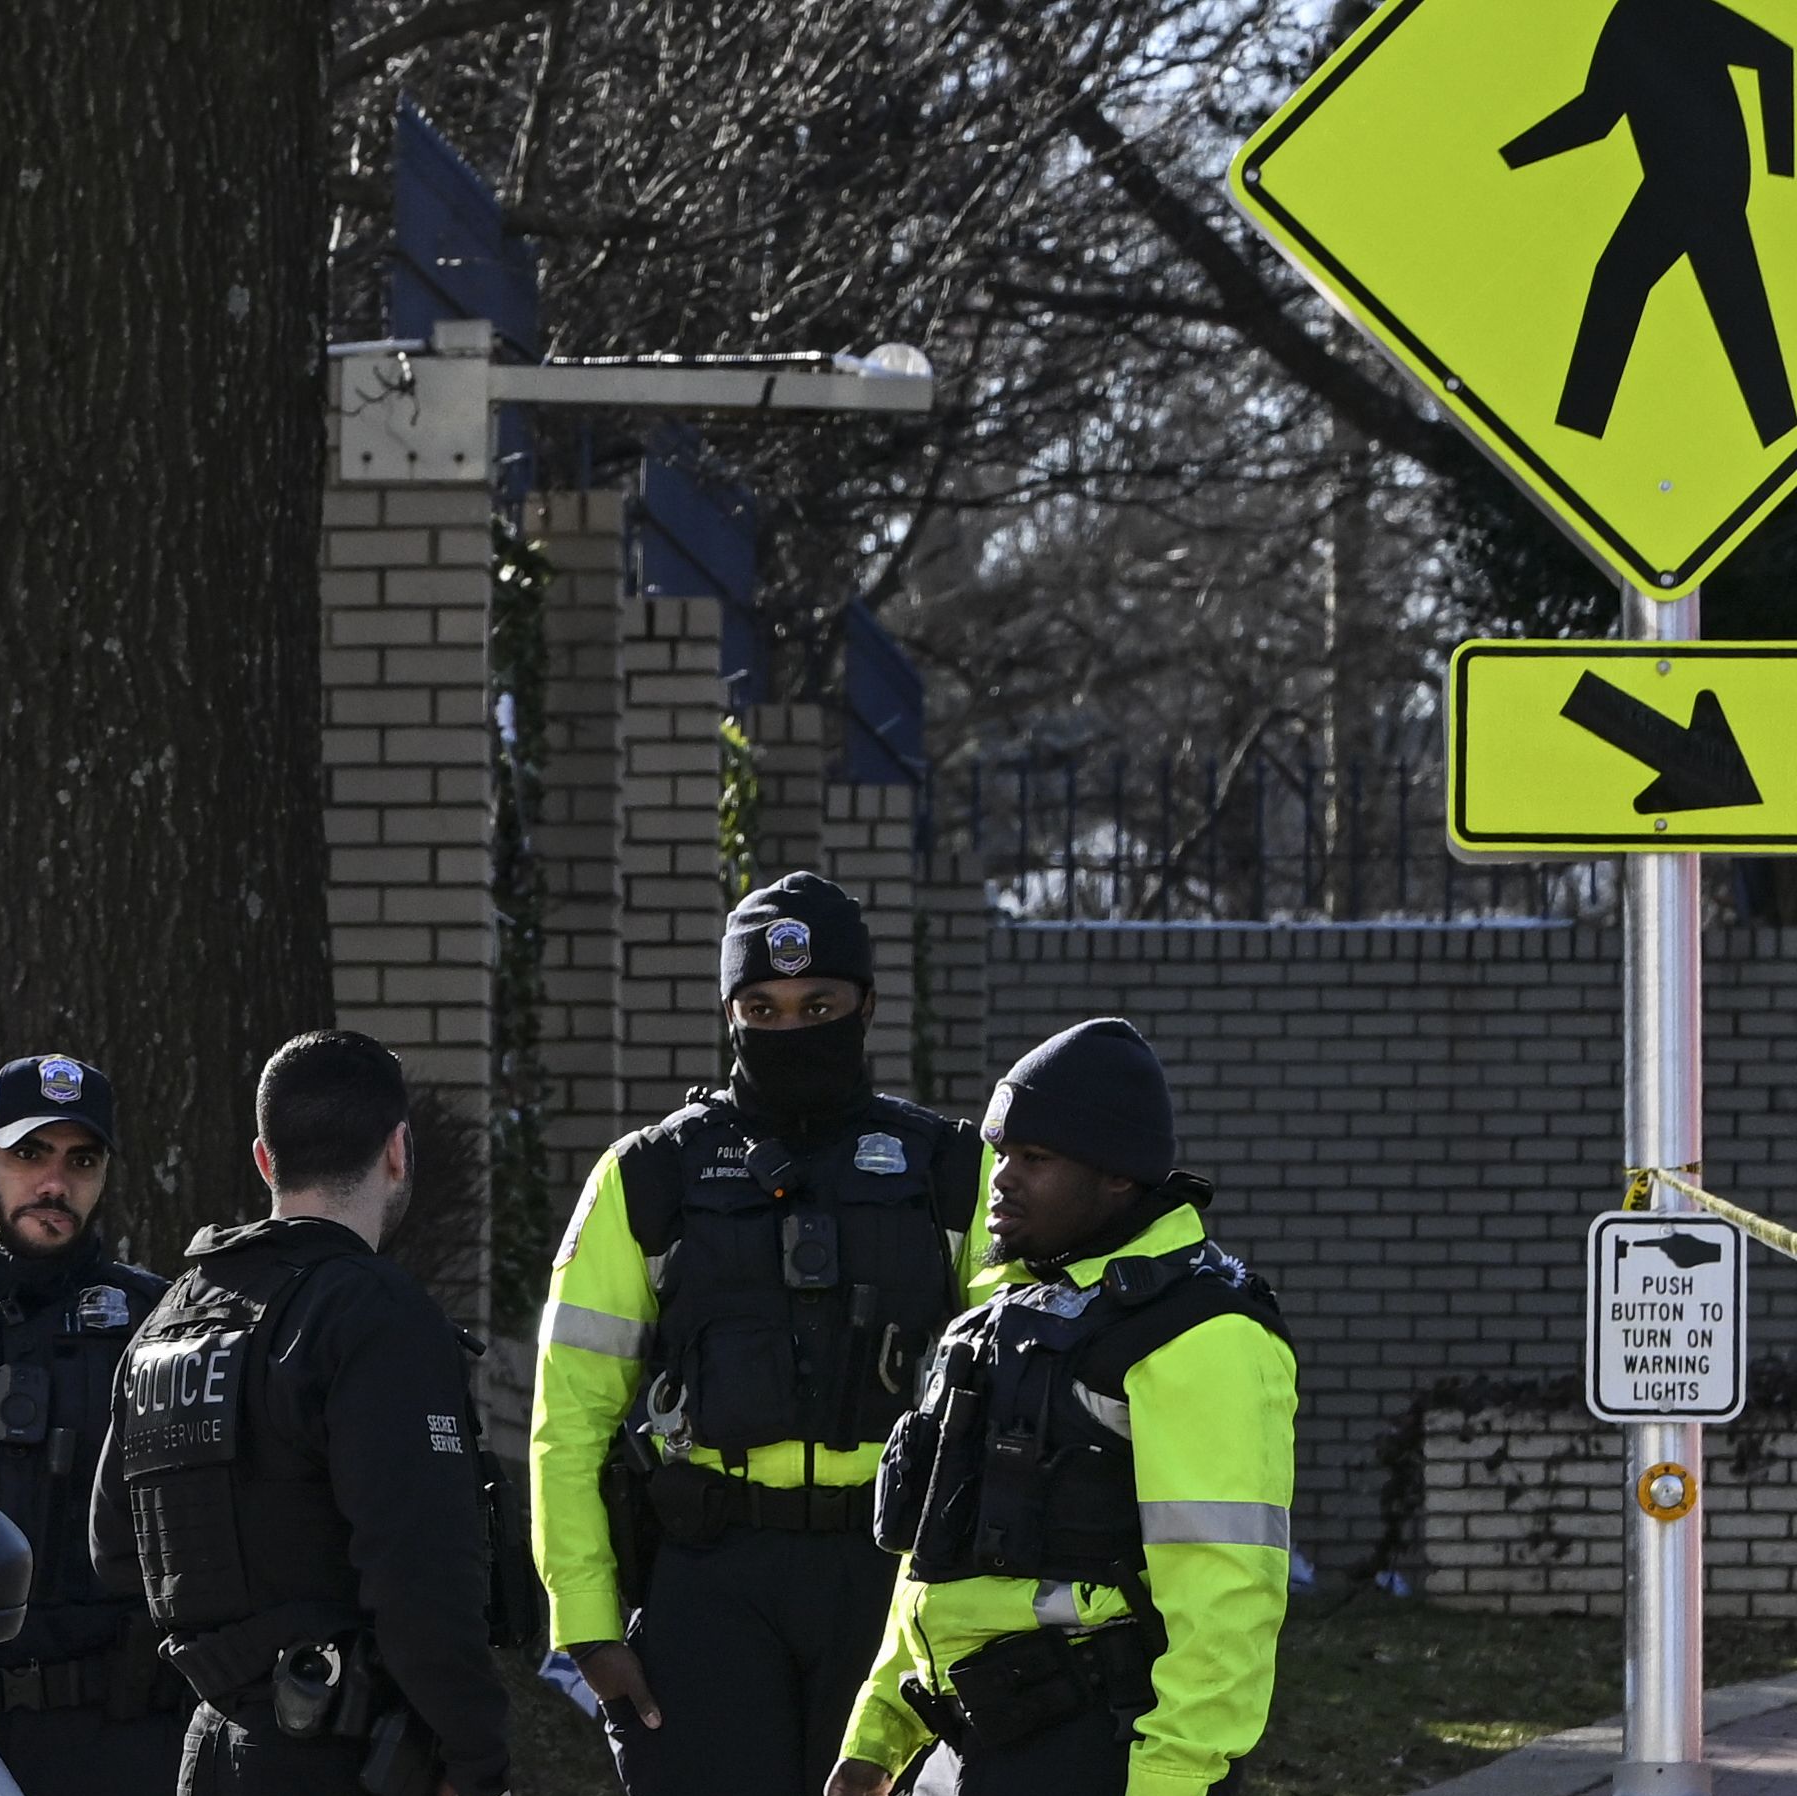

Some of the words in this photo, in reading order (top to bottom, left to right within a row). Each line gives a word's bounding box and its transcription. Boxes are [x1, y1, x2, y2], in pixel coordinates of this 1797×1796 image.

[716, 1146, 745, 1159] POLIC
[715, 1166, 750, 1178] BRIDGE
[1641, 1275, 1694, 1296] PUSH
[1611, 1302, 1684, 1322] BUTTON
[1700, 1302, 1724, 1322] TO
[1622, 1328, 1672, 1348] TURN
[1687, 1328, 1713, 1348] ON
[1623, 1354, 1710, 1375] WARNING
[1633, 1381, 1700, 1402] LIGHTS
[163, 1418, 223, 1450] SERVICE
